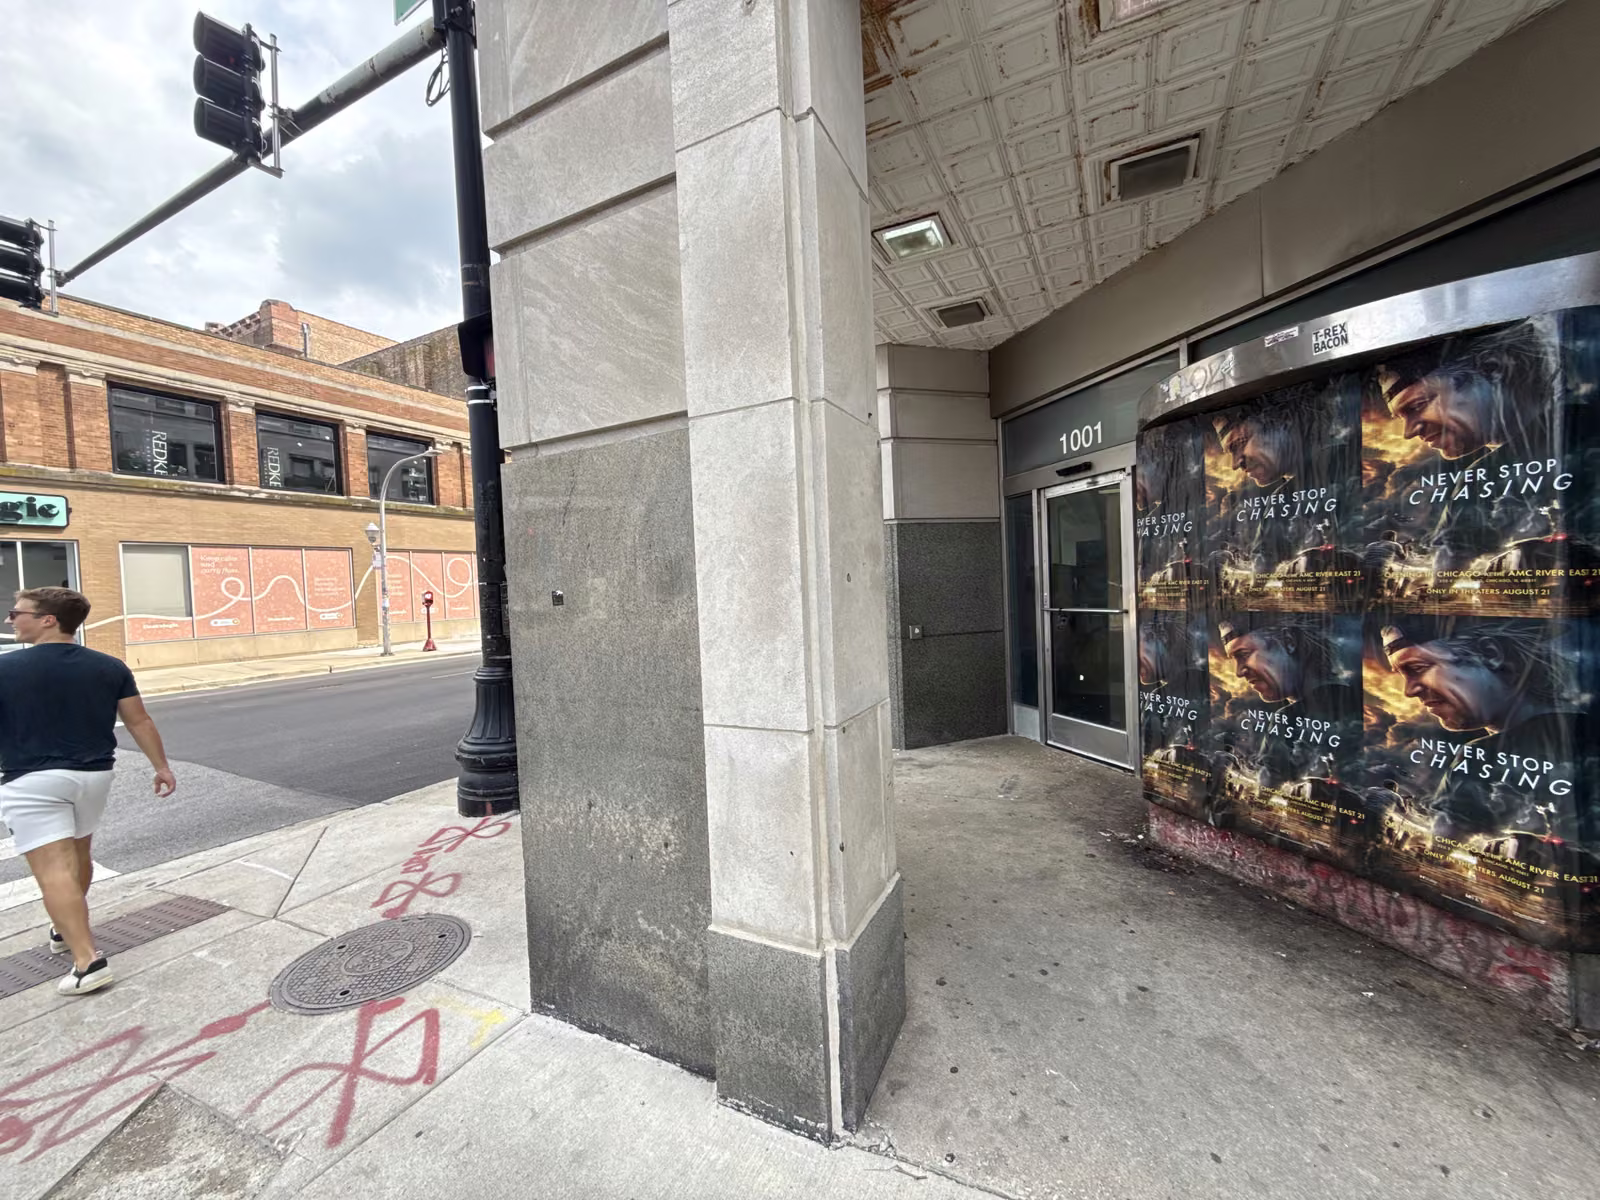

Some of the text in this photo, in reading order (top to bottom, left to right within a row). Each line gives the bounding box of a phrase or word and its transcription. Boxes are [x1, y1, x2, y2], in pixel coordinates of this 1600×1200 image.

[1313, 322, 1347, 342] T-REX
[1313, 333, 1349, 354] BACON
[1060, 421, 1102, 454] 1001
[1421, 458, 1556, 487] NEVER STOP
[1243, 487, 1327, 508] NEVER STOP
[1409, 473, 1574, 505] CHASING
[1161, 512, 1186, 524] STOP
[1236, 498, 1337, 522] CHASING
[1569, 568, 1590, 576] EAST
[1592, 568, 1600, 576] 21
[1166, 695, 1190, 708] STOP
[1248, 708, 1331, 732] NEVER STOP
[1240, 718, 1341, 748] CHASING
[1421, 737, 1554, 774] NEVER STOP
[1410, 750, 1573, 796] CHASING
[1301, 810, 1323, 821] AUGUST
[1304, 799, 1319, 807] AMC
[1339, 807, 1355, 817] EAST
[1357, 812, 1365, 820] 21
[1424, 849, 1444, 859] ONLY
[1499, 873, 1532, 890] AUGUST
[1533, 886, 1545, 894] 21
[1435, 835, 1478, 853] CHICAGO
[1505, 858, 1527, 870] AMC
[1529, 865, 1560, 880] RIVER
[1563, 874, 1588, 884] EAST
